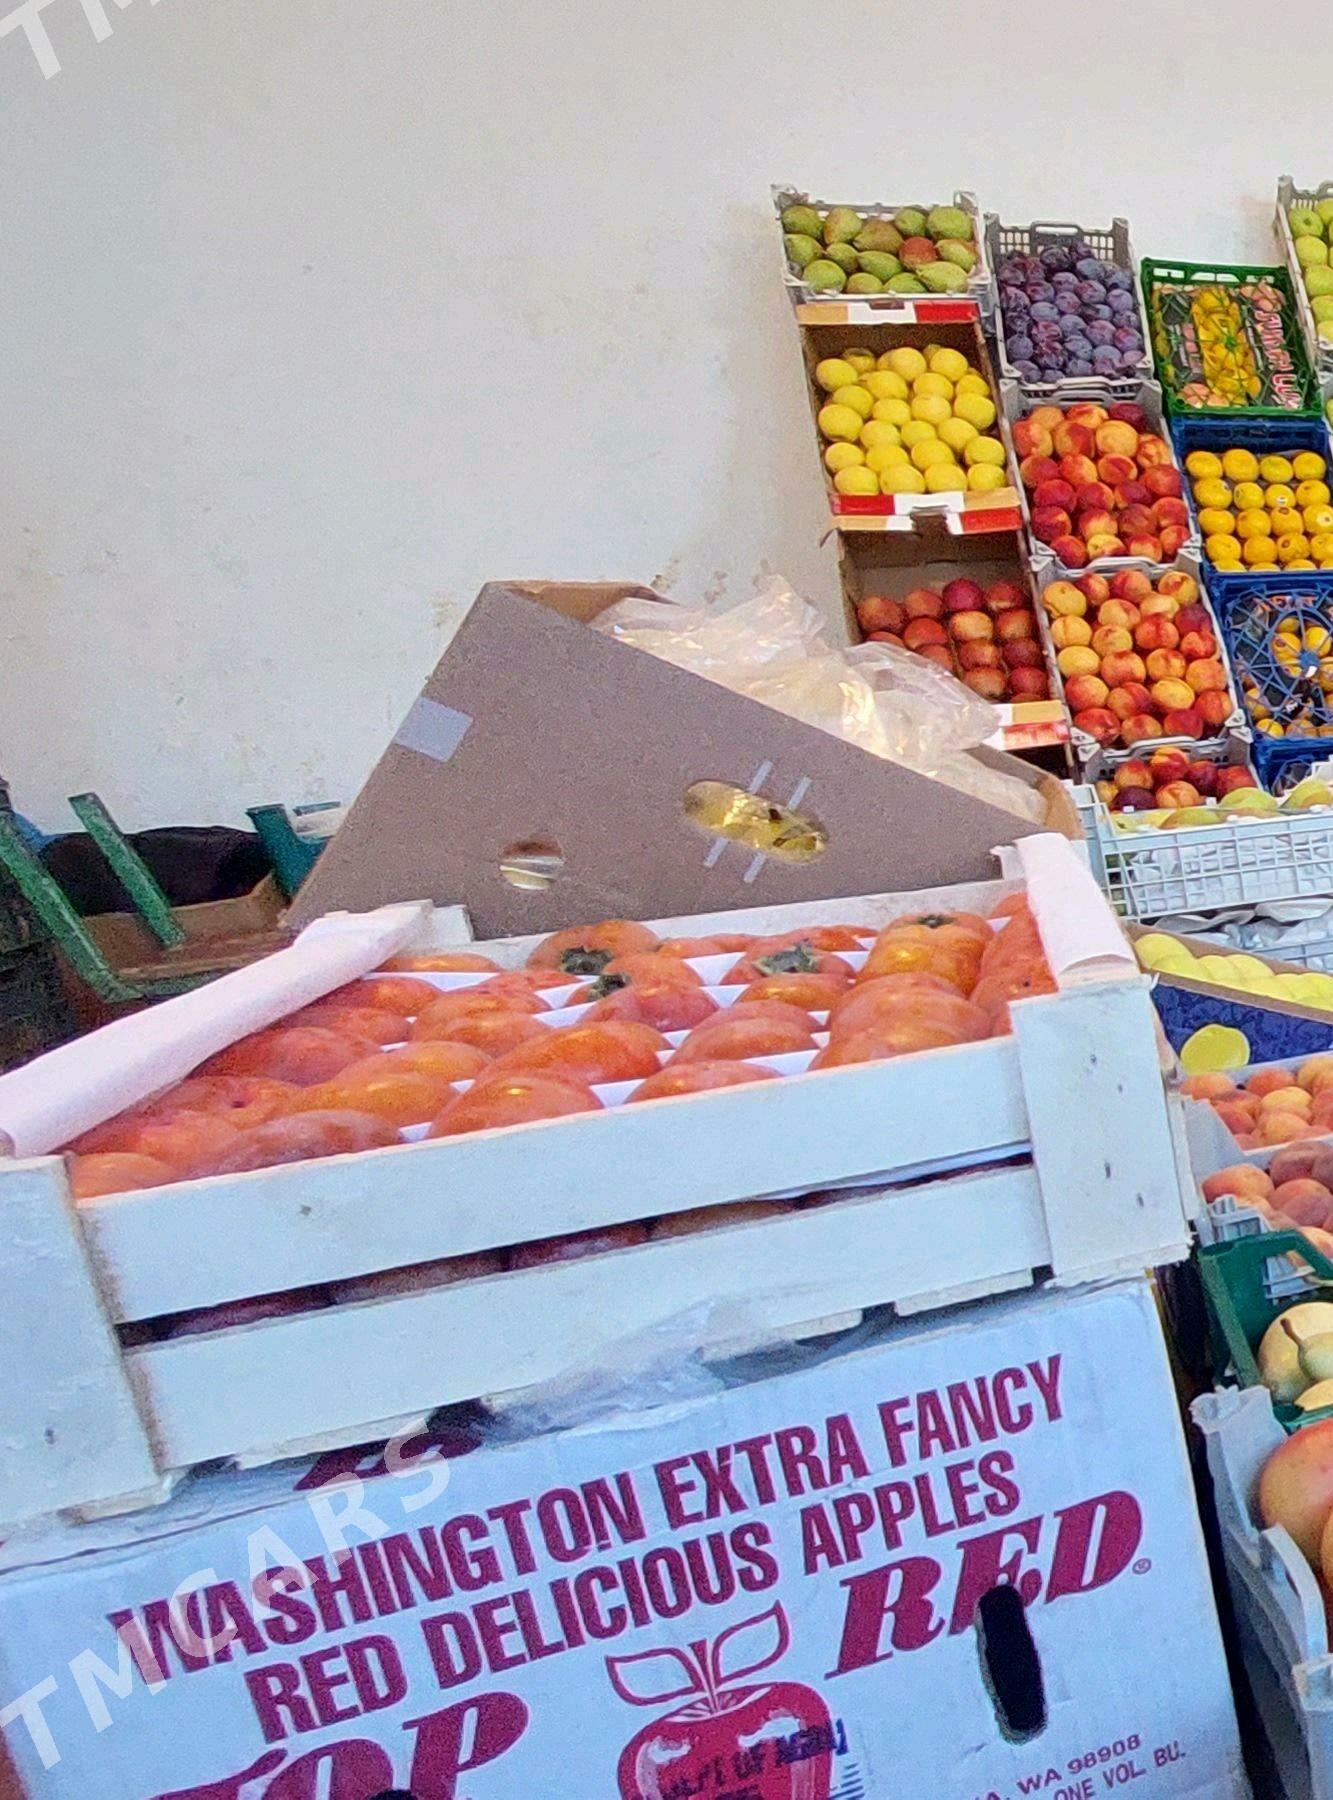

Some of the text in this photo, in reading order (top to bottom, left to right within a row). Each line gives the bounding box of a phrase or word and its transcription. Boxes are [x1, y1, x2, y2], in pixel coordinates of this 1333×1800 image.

[106, 1352, 1063, 1686] WASHINGTON EXTRA FANCY
[243, 1449, 1021, 1745] RED DELICIOUS APPLES
[824, 1489, 1143, 1680] RED
[1016, 1733, 1142, 1796] WA 98908
